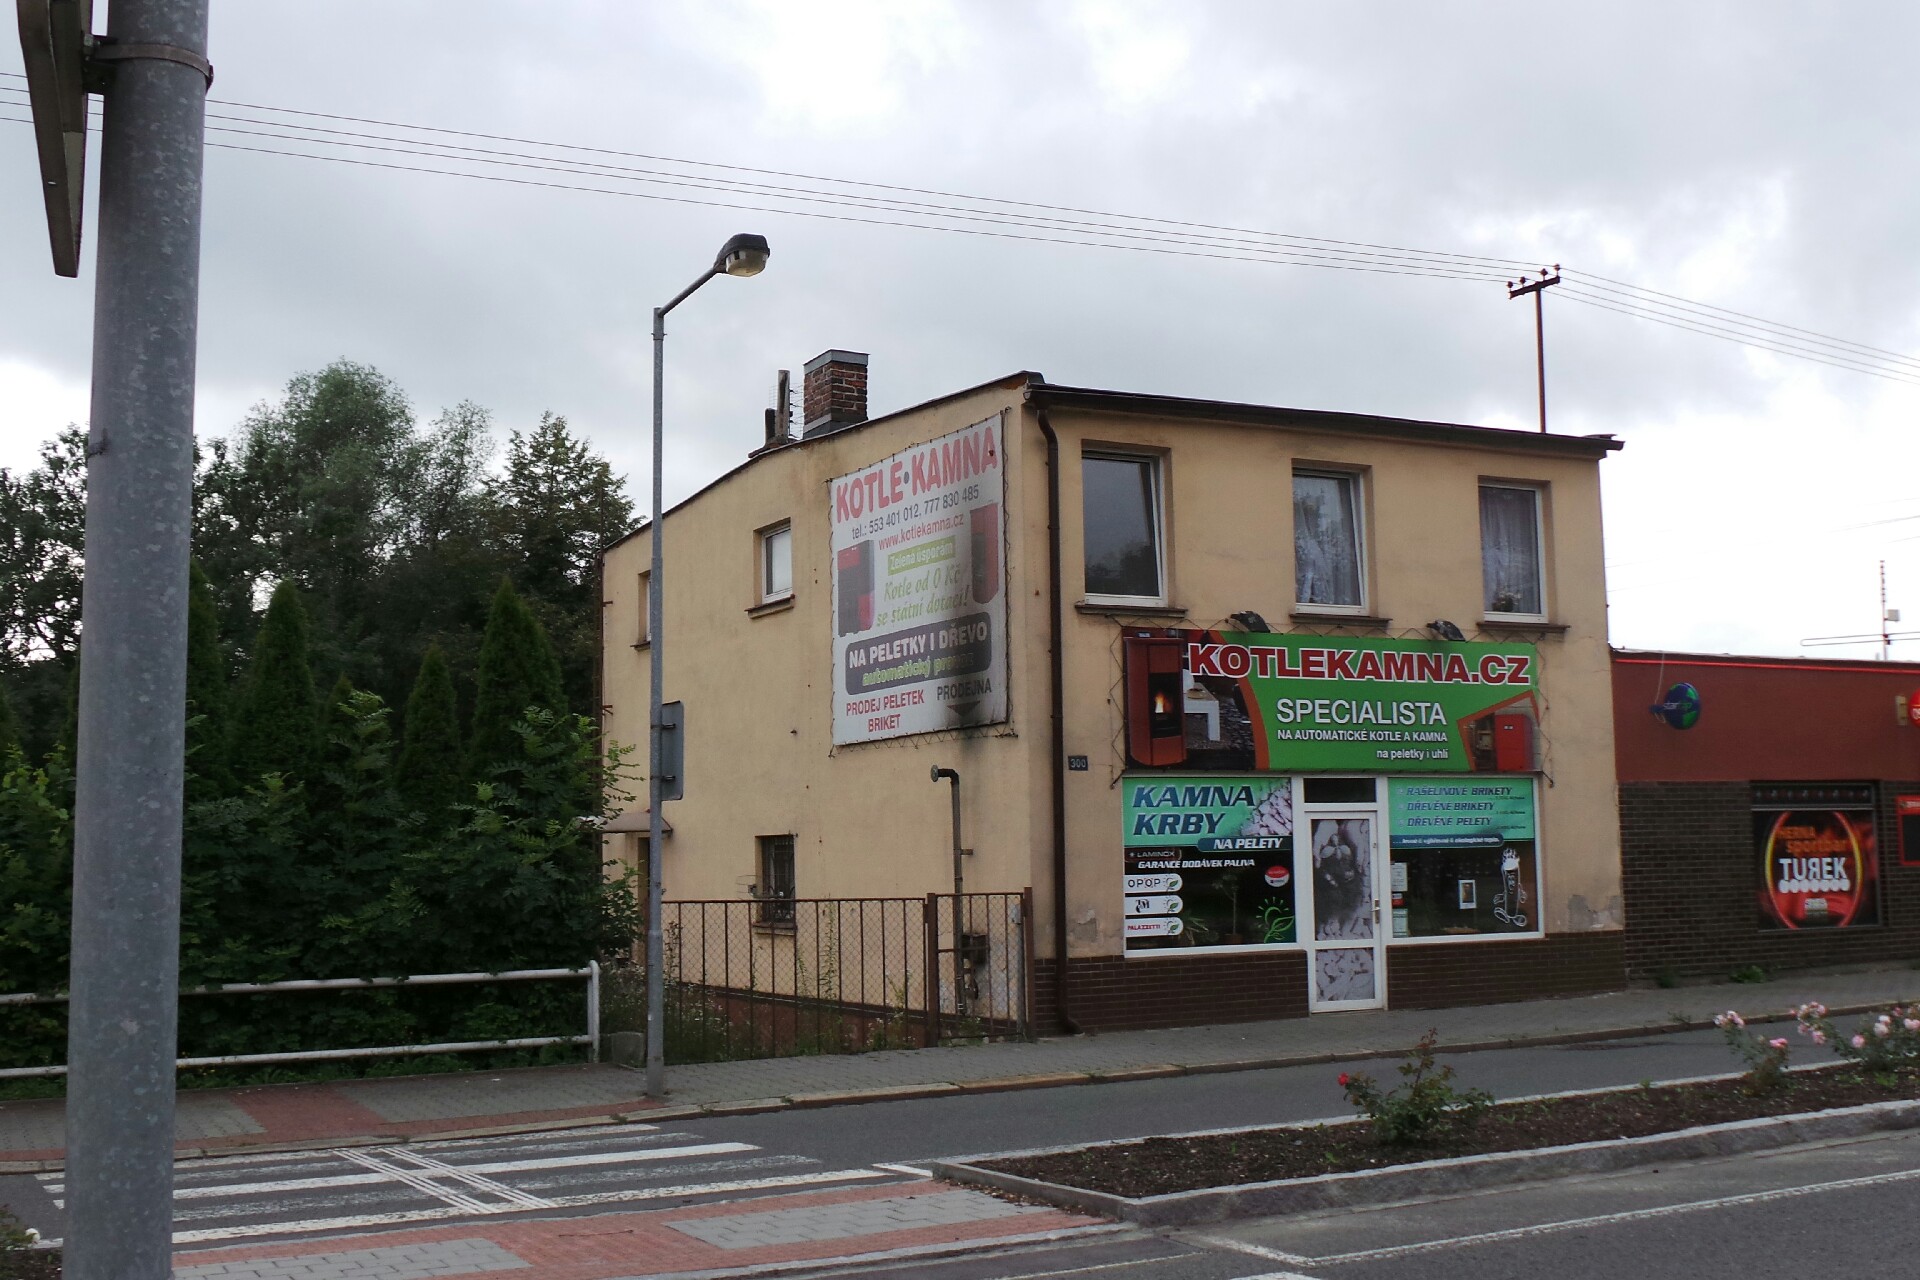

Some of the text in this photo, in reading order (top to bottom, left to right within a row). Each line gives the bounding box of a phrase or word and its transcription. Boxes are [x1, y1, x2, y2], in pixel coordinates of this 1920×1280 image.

[836, 426, 998, 523] KOTLE KAMNA
[852, 526, 867, 540] tel.:
[869, 518, 884, 535] 553
[886, 513, 900, 527] 401
[924, 497, 940, 515] 777
[942, 491, 960, 509] 830
[962, 484, 979, 502] 485
[878, 512, 964, 551] www.kotlekamna.cz
[915, 570, 930, 593] od
[877, 612, 888, 626] se
[849, 621, 988, 669] NA PELETKY I DŘEVO
[862, 655, 931, 686] automatický
[1187, 642, 1531, 686] KOTLEKAMNA.CZ
[936, 678, 992, 701] PRODEJNA
[846, 690, 925, 716] PRODEJ PELETEK
[1276, 698, 1447, 725] SPECIALISTA
[868, 713, 901, 733] BRIKET
[1277, 728, 1448, 742] NA AUTOMATICKÉ KOTLE A KAMNA
[1071, 758, 1086, 768] 300
[1376, 749, 1389, 759] na
[1391, 748, 1425, 761] peletky
[1132, 784, 1256, 808] KAMNA
[1471, 786, 1513, 796] BRIKETY
[1453, 802, 1495, 811] BRIKETY
[1132, 812, 1226, 836] KRBY
[1456, 816, 1493, 826] PELETY
[1213, 837, 1284, 850] NA PELETY
[1138, 858, 1256, 869] GARANCE DODÁVEK PALIVA
[1127, 878, 1161, 889] OPOP
